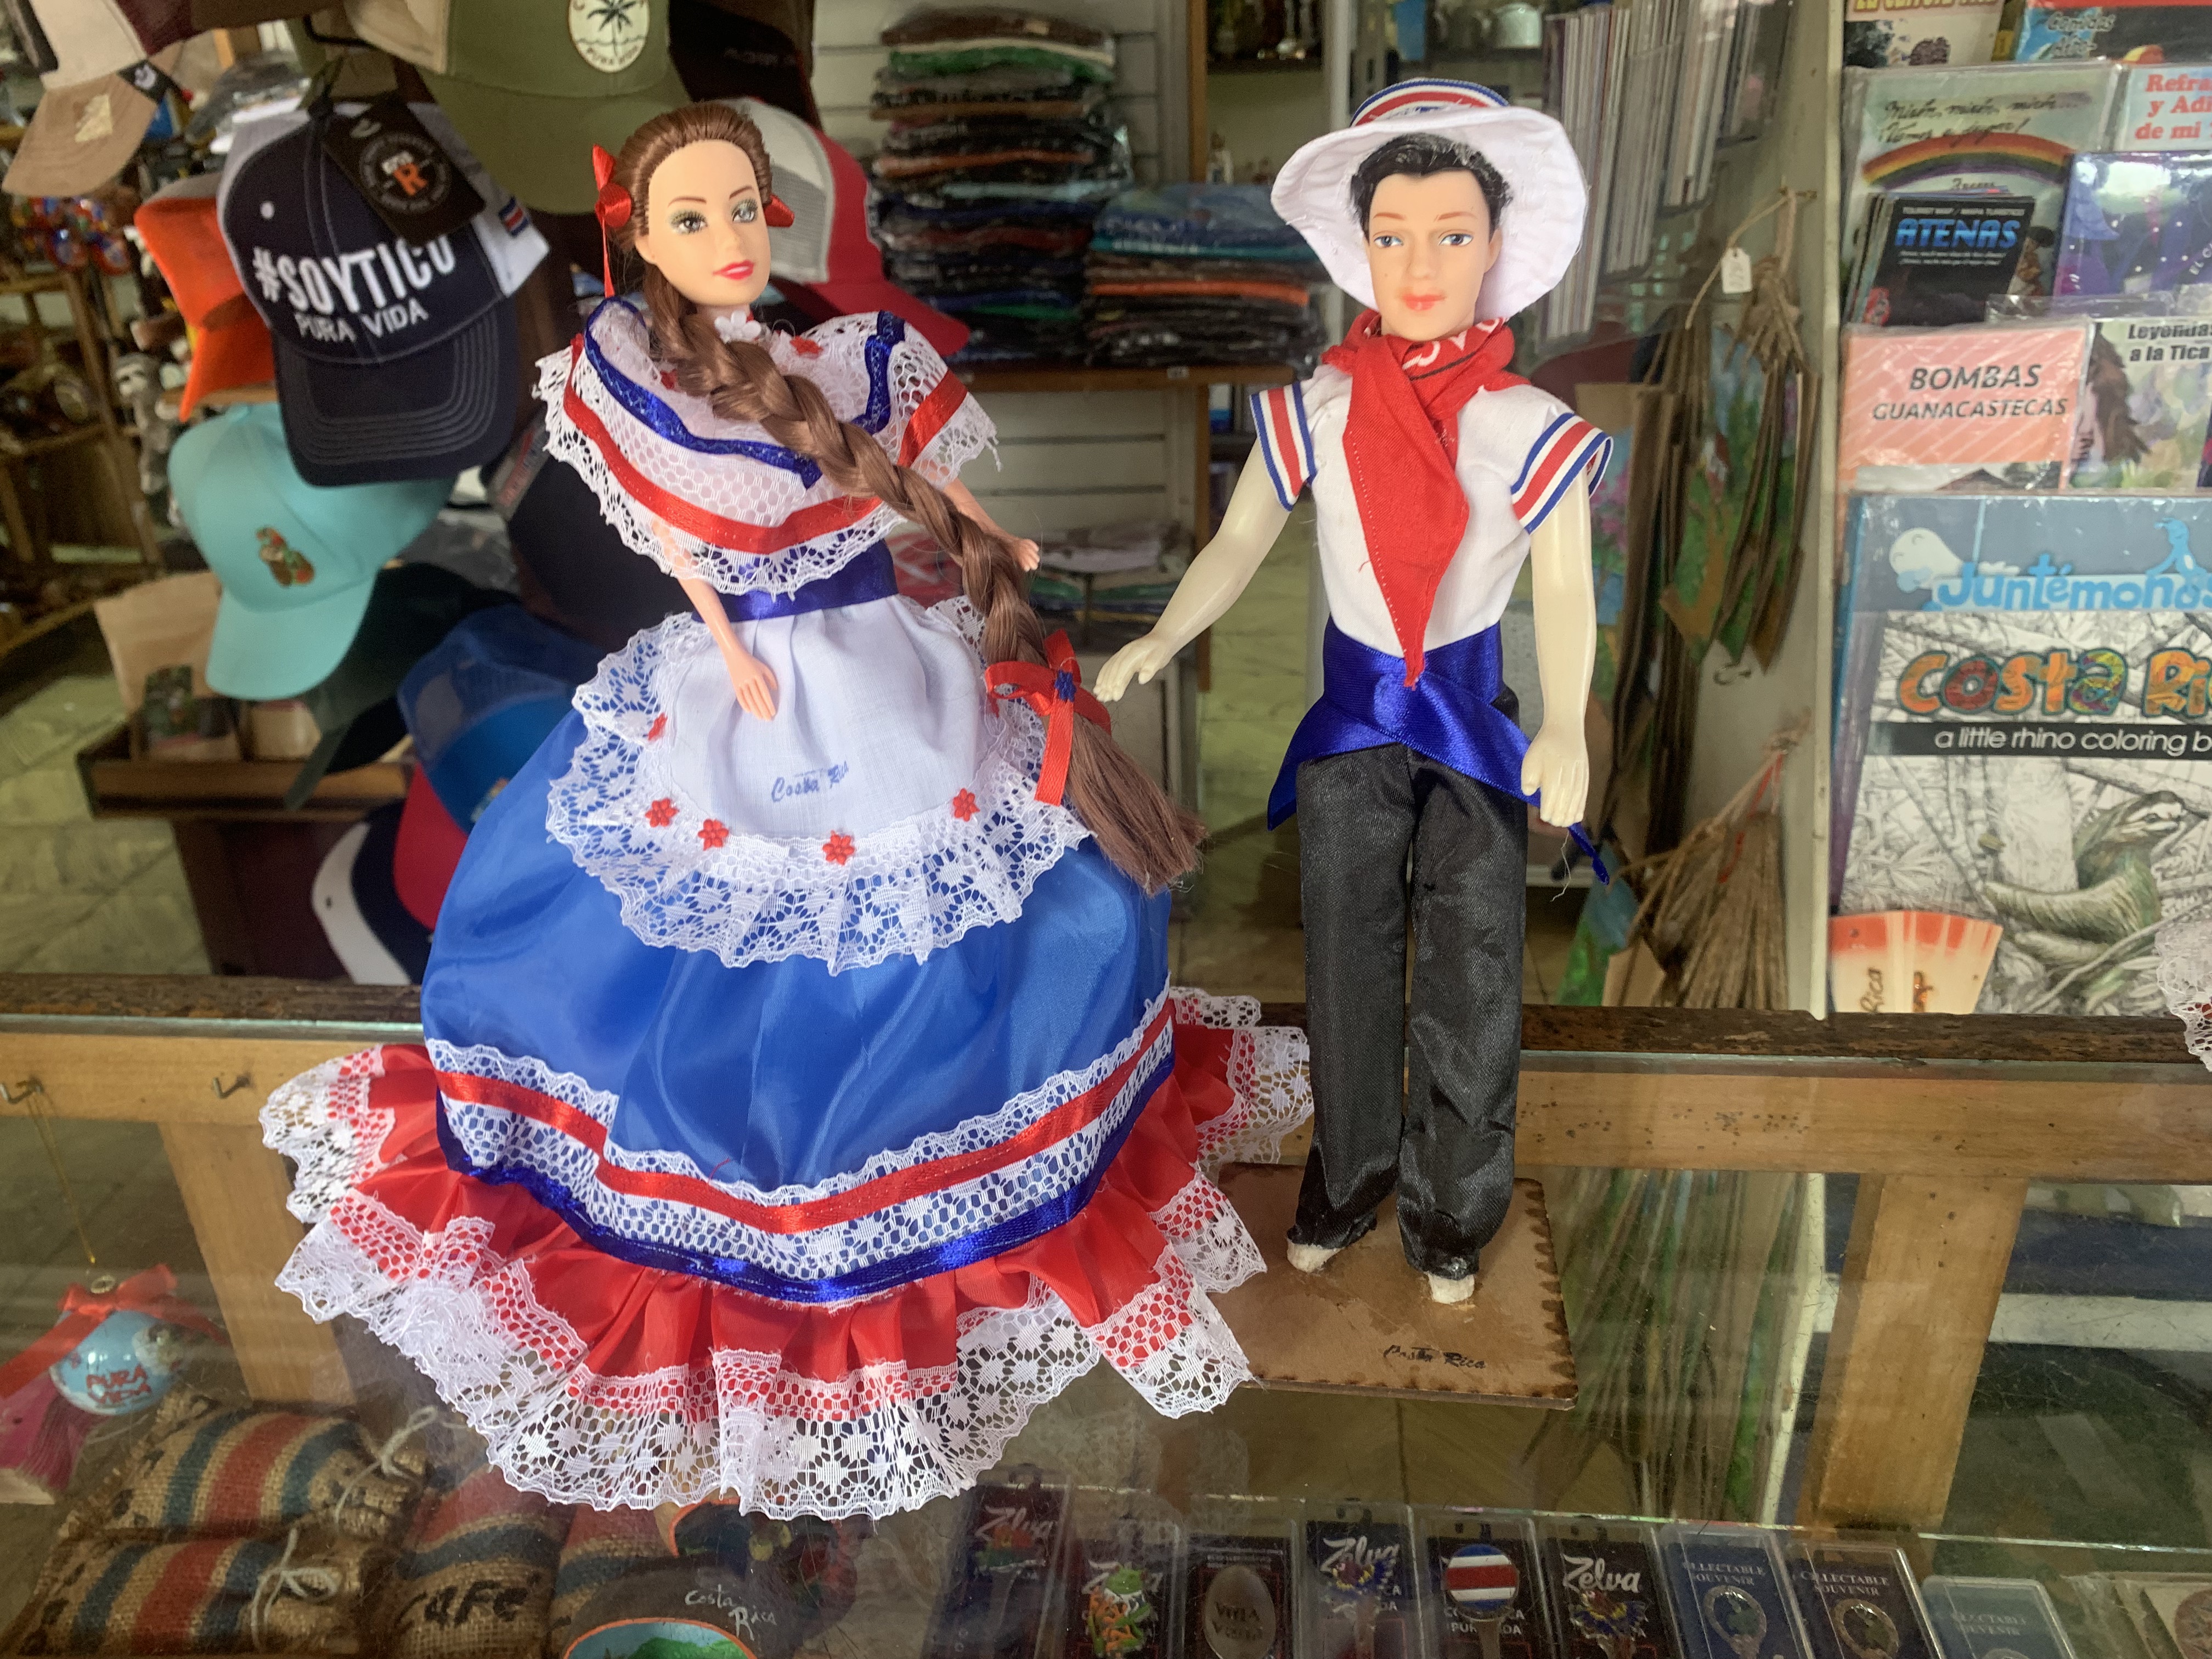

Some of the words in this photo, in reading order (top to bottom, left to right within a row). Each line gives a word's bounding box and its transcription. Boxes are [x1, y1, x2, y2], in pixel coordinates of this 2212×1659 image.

[2147, 100, 2165, 118] y
[2135, 122, 2163, 139] de
[2170, 121, 2202, 139] mi
[1894, 218, 2021, 249] ATENAS
[295, 312, 357, 342] PURA
[361, 297, 430, 338] VIDA
[2128, 324, 2212, 340] Leyenda
[2130, 349, 2141, 362] a
[2146, 346, 2164, 361] la
[2170, 345, 2210, 360] Tica
[1909, 364, 2042, 390] BOMBAS
[1872, 398, 2069, 421] GUANACASTECAS
[1898, 648, 2128, 715] Costa
[2142, 647, 2212, 718] Ri
[1935, 732, 1953, 749] a
[1958, 727, 2006, 748] little
[2011, 728, 2076, 750] rhino
[2081, 731, 2187, 757] coloring
[2192, 731, 2212, 753] b
[1443, 1351, 1486, 1369] Rica
[86, 1363, 148, 1389] PURA
[1562, 1554, 1641, 1593] Zelva
[684, 1584, 737, 1609] Costa
[728, 1605, 777, 1641] Rica
[1450, 1622, 1477, 1633] PUR
